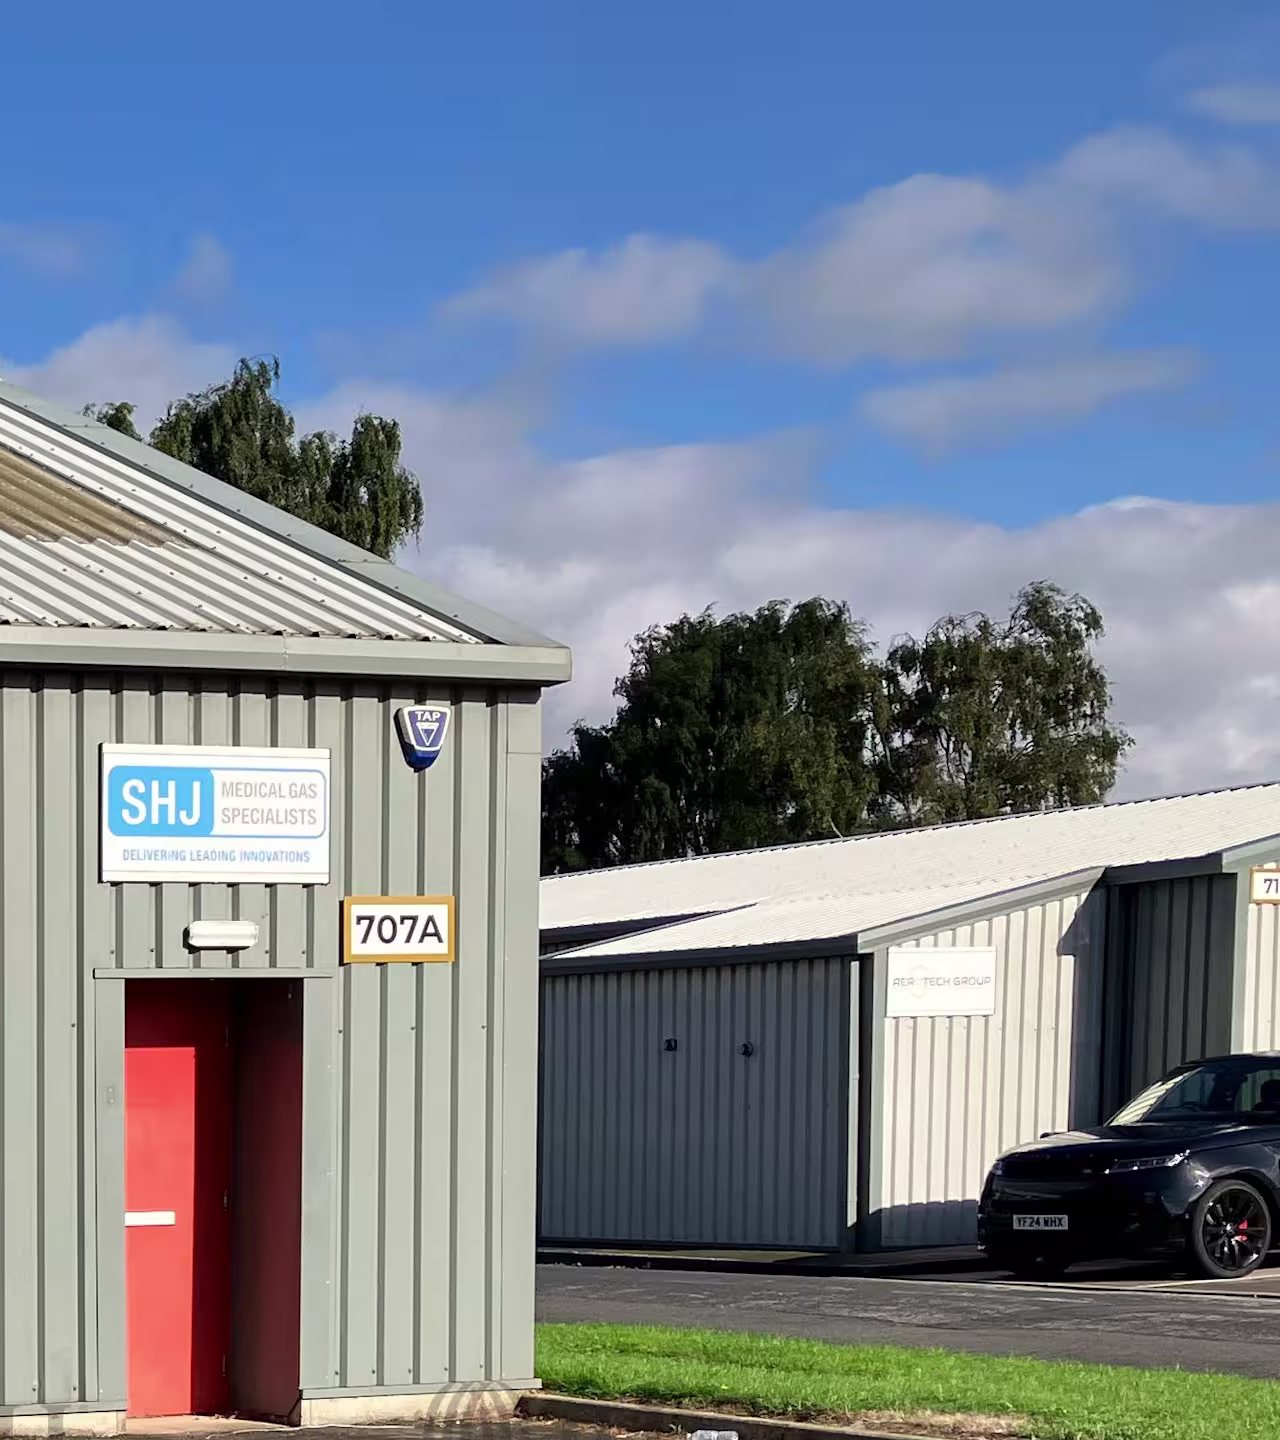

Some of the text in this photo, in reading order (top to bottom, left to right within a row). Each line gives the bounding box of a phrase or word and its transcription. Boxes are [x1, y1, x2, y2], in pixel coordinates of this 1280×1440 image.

[414, 711, 441, 722] TAP
[221, 781, 317, 800] MEDICAL GAS
[121, 778, 201, 826] SHJ
[221, 807, 317, 825] SPECIALISTS
[122, 848, 310, 863] DELIVERING LEADING INNOVATIONS
[355, 914, 444, 944] 707A
[953, 976, 992, 986] GROUP
